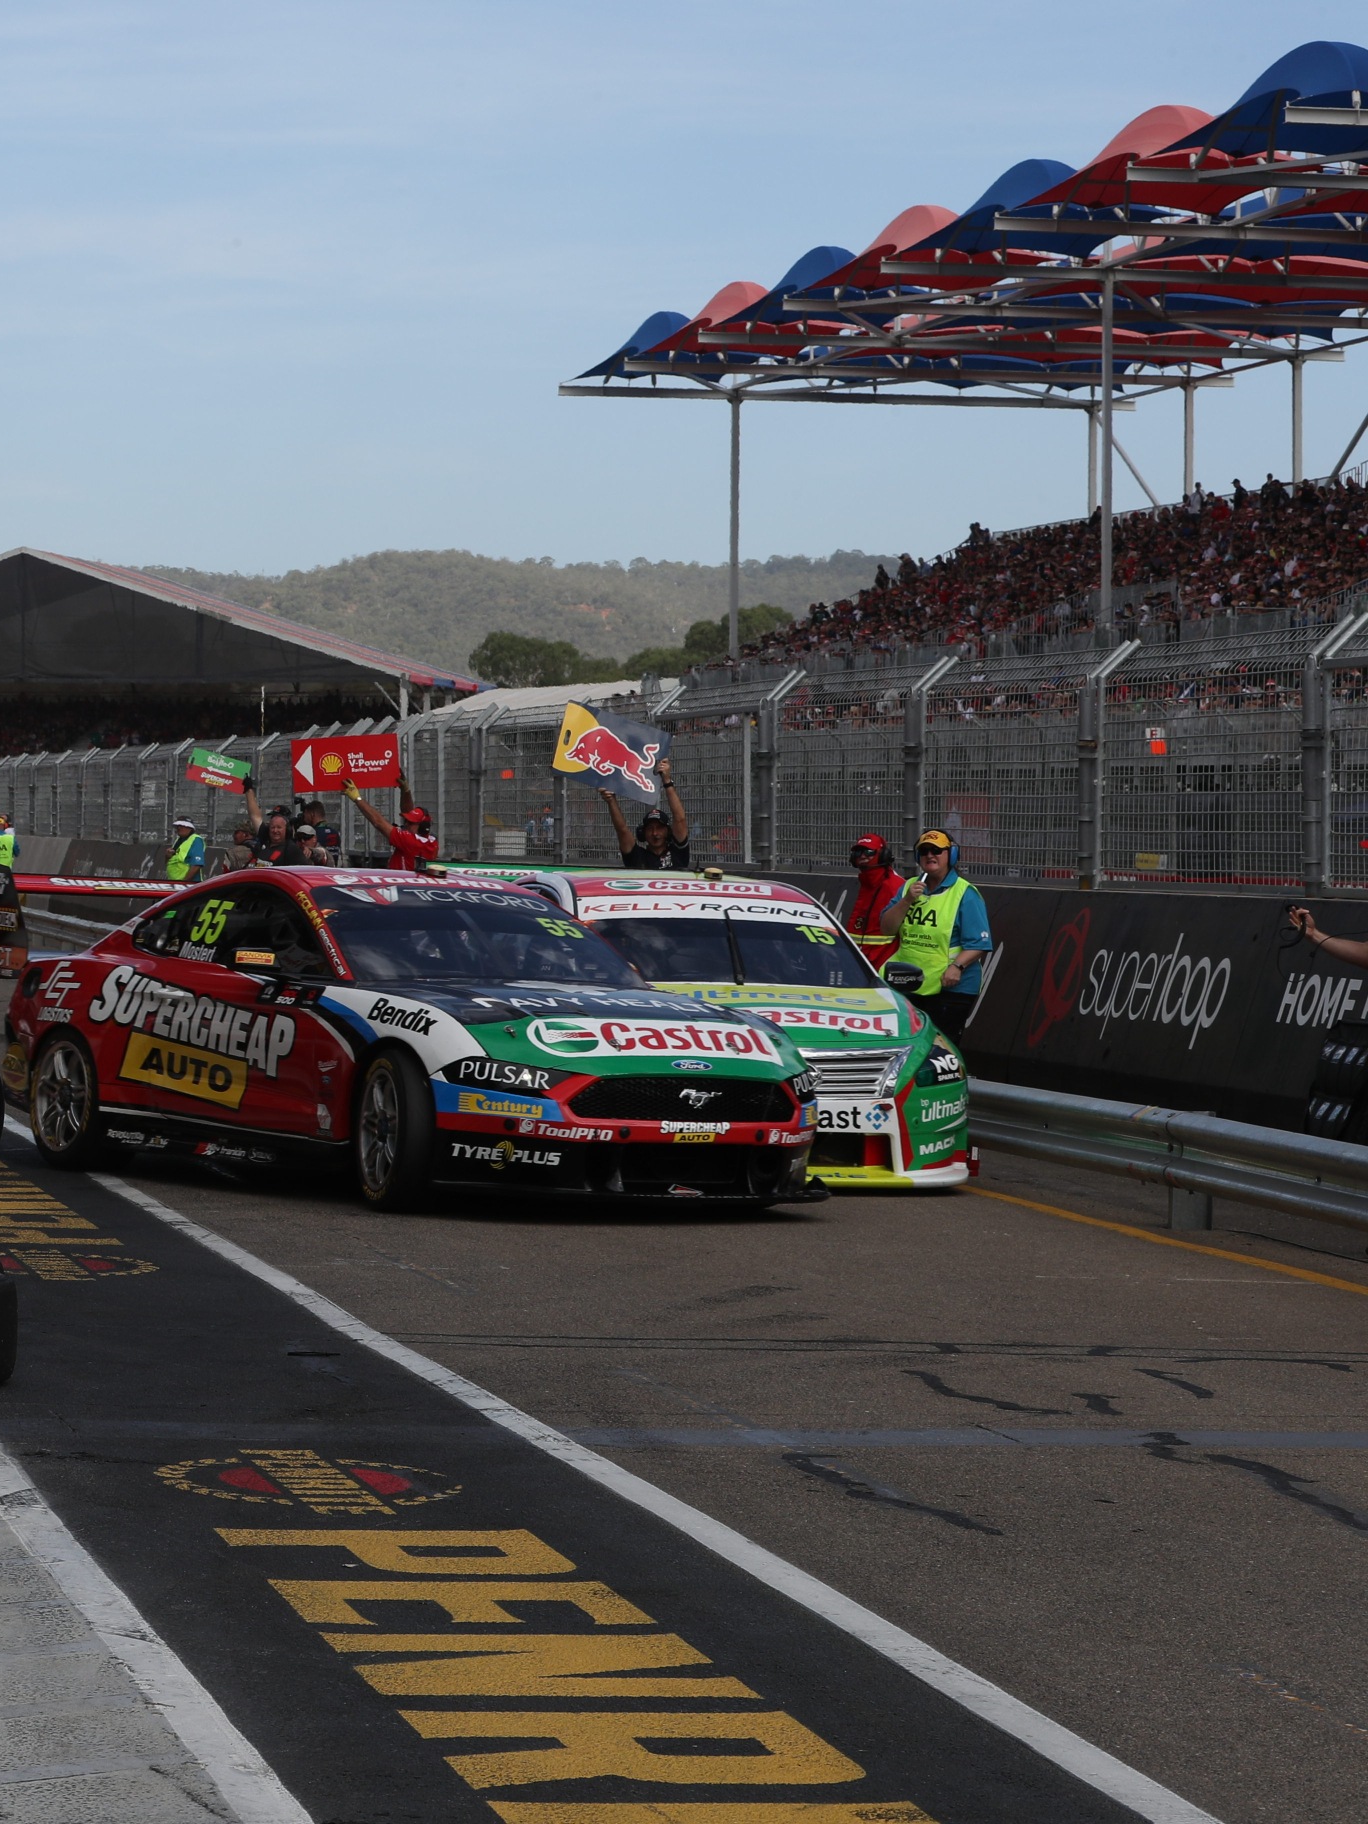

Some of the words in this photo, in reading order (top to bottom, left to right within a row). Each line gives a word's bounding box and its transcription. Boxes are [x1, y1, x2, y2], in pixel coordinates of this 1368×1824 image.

[347, 752, 363, 760] Shell
[348, 757, 390, 767] V-Power
[362, 875, 505, 890] ToolPRO
[463, 868, 534, 878] Castrol
[648, 881, 765, 894] Castrol
[402, 889, 549, 913] TICKFORD
[583, 903, 697, 914] KELLY
[699, 903, 821, 920] RACING
[190, 898, 235, 945] 55
[535, 917, 584, 940] 55
[795, 925, 836, 946] 15
[178, 941, 218, 963] Mostert
[237, 951, 273, 959] SANDVIK
[1078, 932, 1231, 1050] superloop
[36, 1007, 74, 1023] LOGISTICS
[89, 965, 297, 1078] SUPERCHEAP
[367, 997, 438, 1037] Bendix
[746, 1010, 895, 1033] astrol
[600, 1022, 773, 1056] Castrol
[140, 1047, 233, 1092] AUTO
[929, 1054, 960, 1074] NG
[459, 1061, 550, 1090] PULSAR
[467, 1092, 544, 1119] Century
[920, 1098, 930, 1108] bp
[660, 1120, 731, 1134] SUPERCHEAP
[817, 1106, 861, 1129] ast
[538, 1123, 614, 1142] ToolPRO
[678, 1133, 712, 1143] AUTO
[919, 1135, 956, 1155] MACK
[213, 1527, 942, 1824] PENRI
